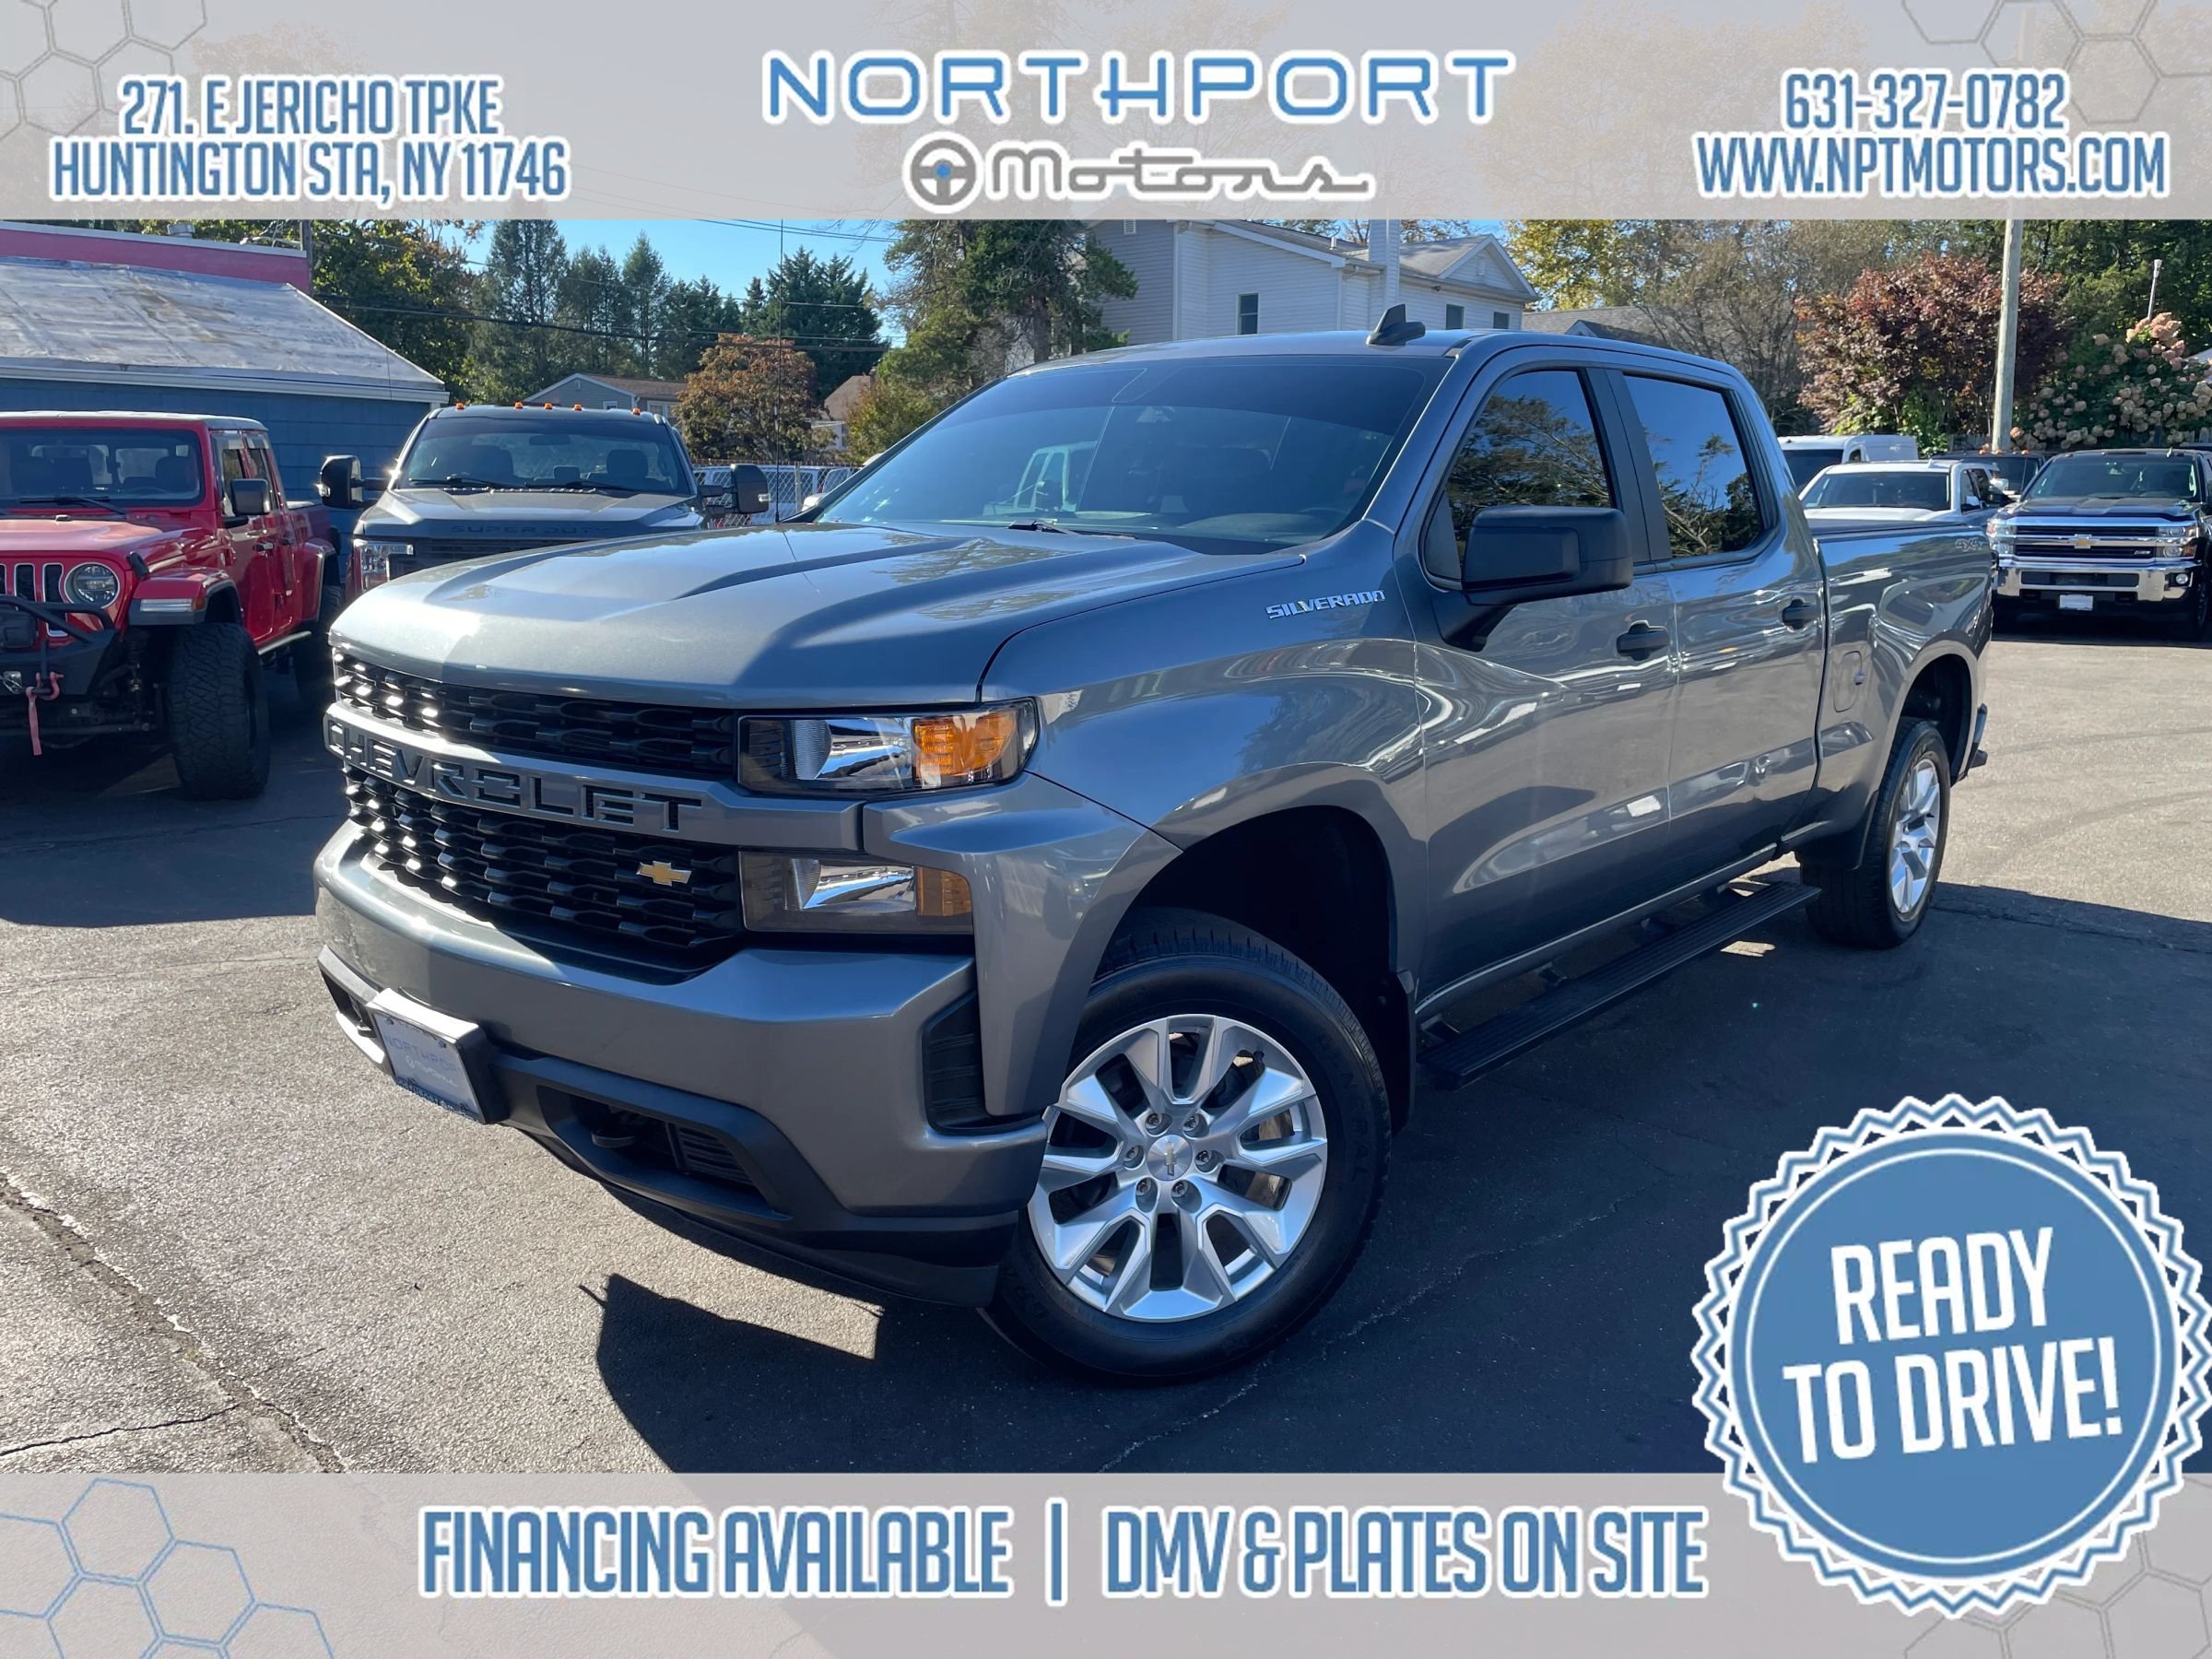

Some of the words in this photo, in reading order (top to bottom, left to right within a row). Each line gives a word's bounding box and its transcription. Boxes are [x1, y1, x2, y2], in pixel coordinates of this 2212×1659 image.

[450, 524, 537, 535] SUPER
[1265, 589, 1386, 620] SILVERADO
[327, 717, 703, 833] CHEVROLET
